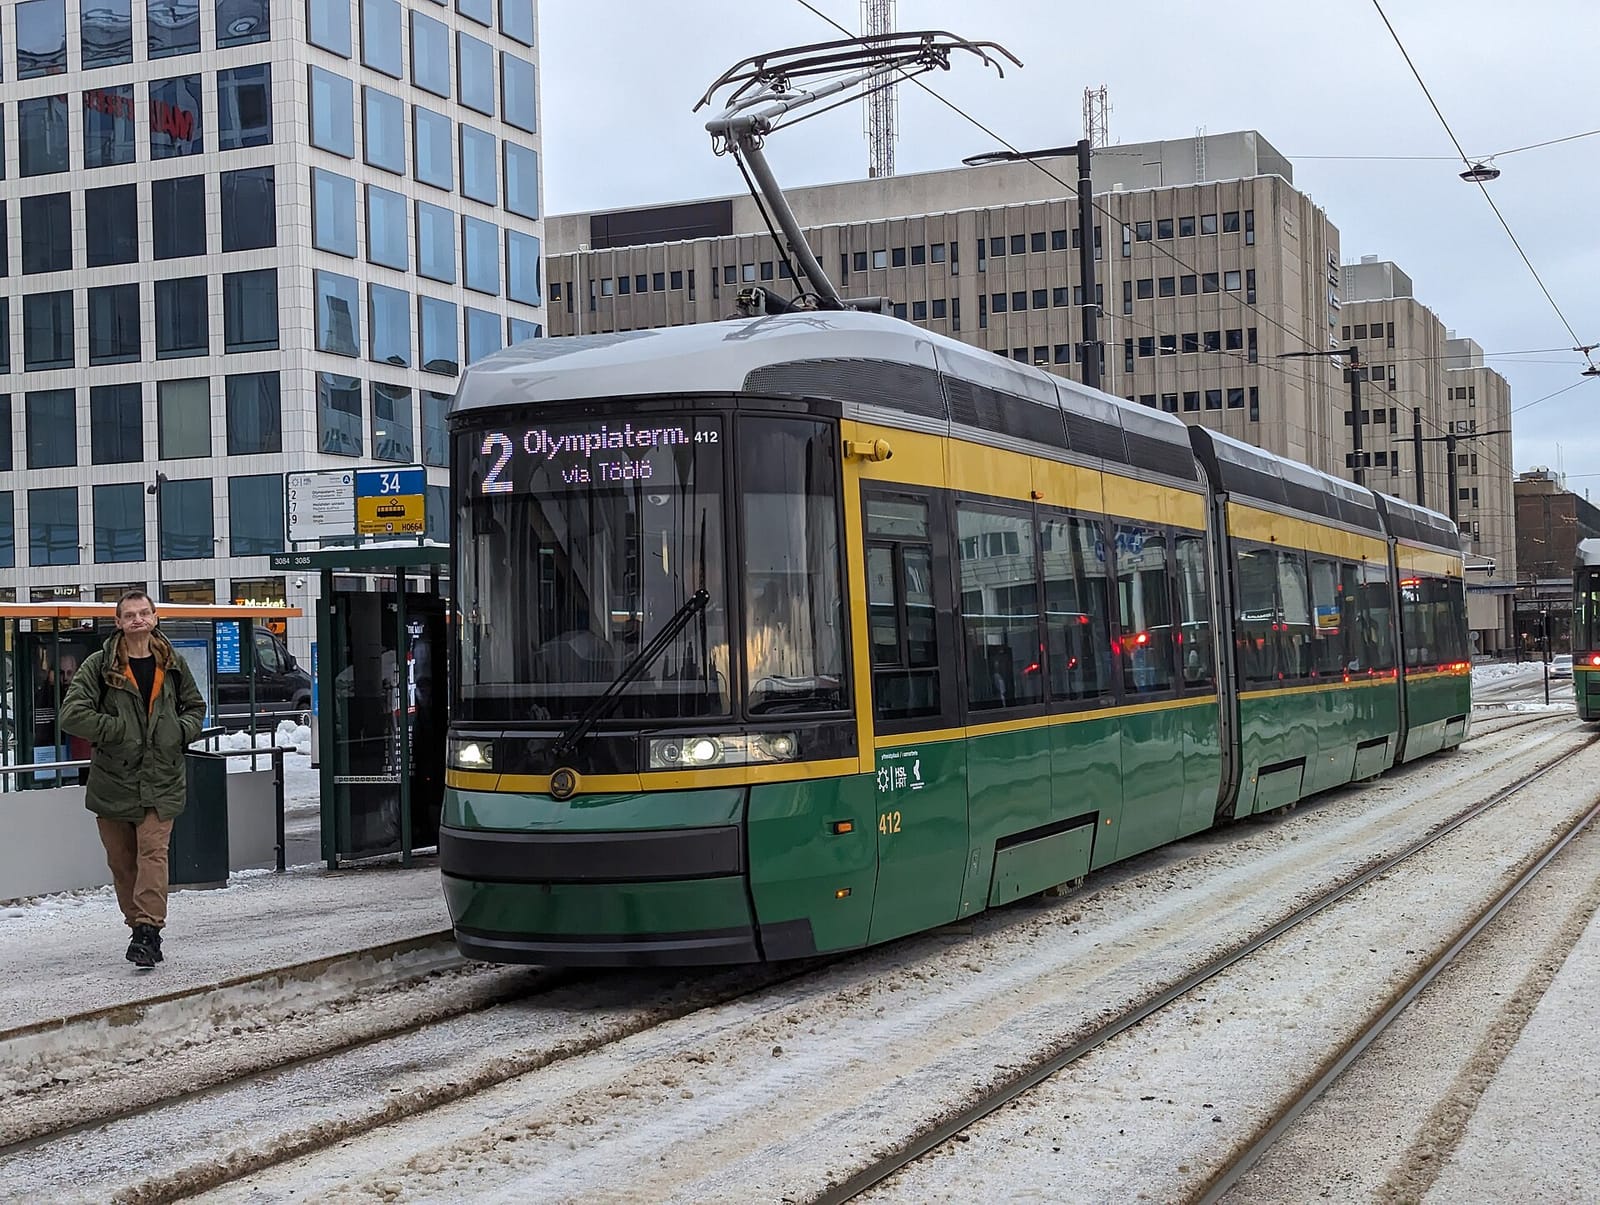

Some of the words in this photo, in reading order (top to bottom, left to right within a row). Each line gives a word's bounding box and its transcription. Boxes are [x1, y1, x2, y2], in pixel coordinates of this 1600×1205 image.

[523, 423, 689, 460] Olympiaterm.
[694, 431, 719, 443] 412
[481, 432, 514, 494] 2
[562, 464, 592, 483] via
[599, 460, 652, 481] Töölö
[380, 473, 401, 494] 34
[291, 490, 297, 500] 2
[291, 502, 297, 512] 7
[291, 514, 298, 524] 9
[274, 557, 290, 565] 3084
[294, 556, 311, 565] 3085
[895, 766, 907, 777] HSL
[879, 810, 902, 835] 412
